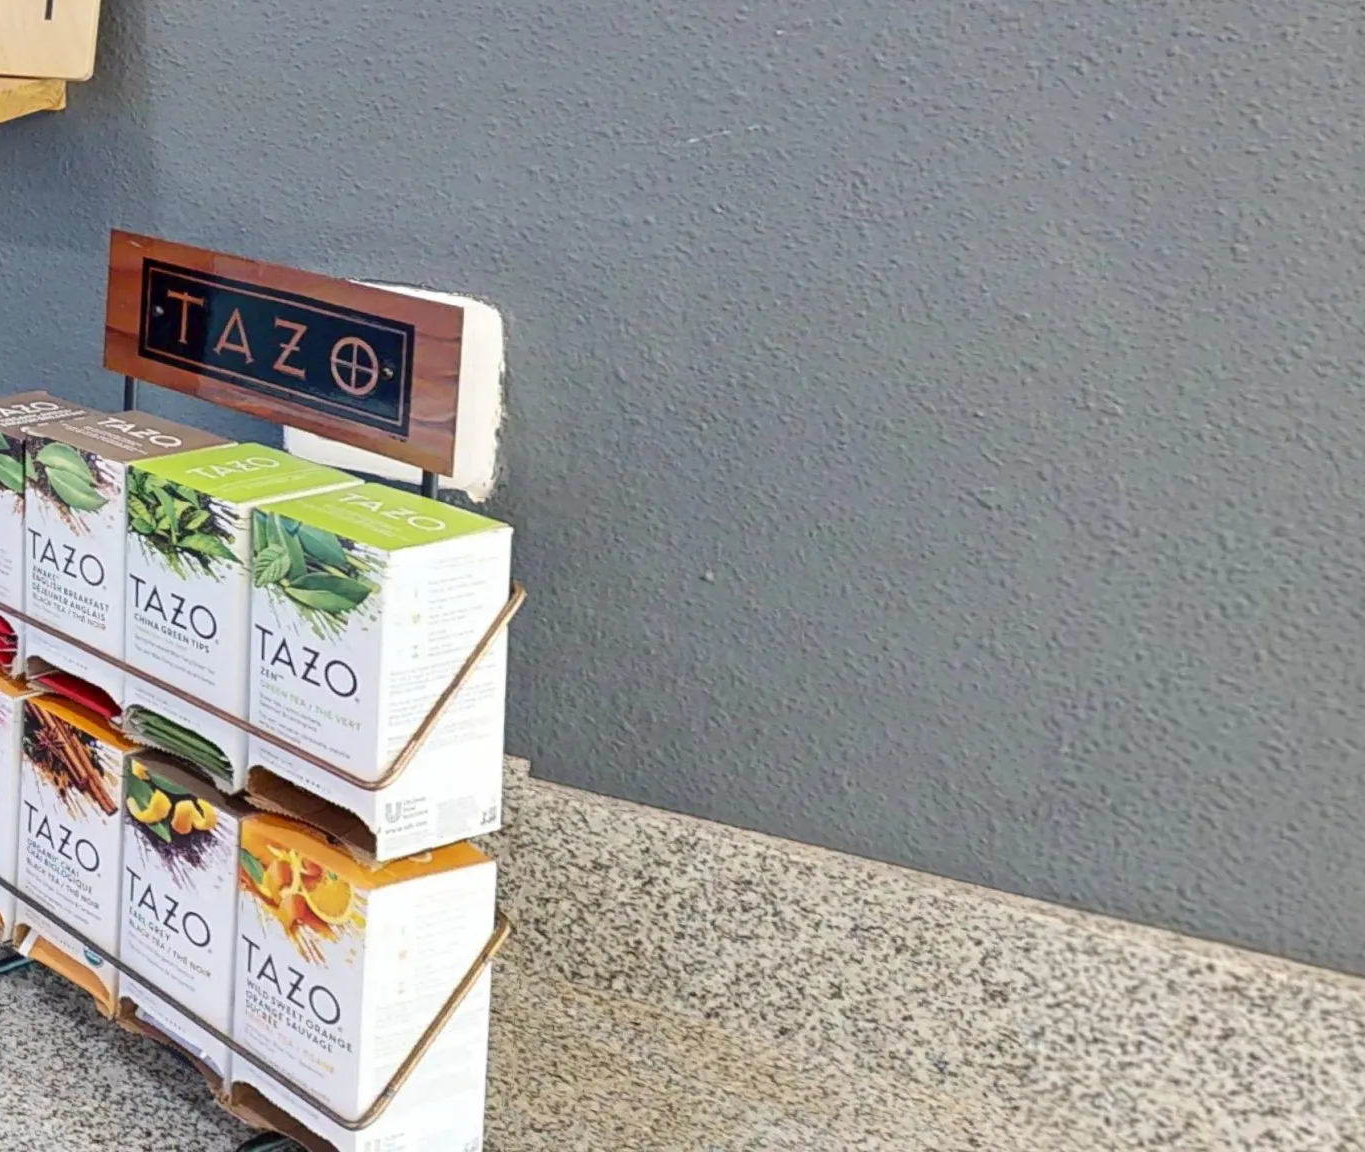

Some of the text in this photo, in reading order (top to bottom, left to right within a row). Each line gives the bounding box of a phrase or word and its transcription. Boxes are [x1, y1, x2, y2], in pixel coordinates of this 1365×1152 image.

[167, 290, 379, 396] TAZO
[97, 417, 183, 448] TAZO
[185, 456, 281, 479] TAZO
[337, 493, 447, 532] TAZO
[27, 527, 105, 587] TAZO
[31, 592, 53, 608] BLACK
[32, 572, 110, 612] ENGLISH BREAKFAST
[69, 600, 106, 622] ANGLAIS
[129, 573, 217, 640] TAZO
[133, 612, 160, 631] CHINA
[160, 625, 190, 644] GREEN
[191, 638, 210, 654] TIPS
[254, 623, 358, 698] TAZO
[260, 679, 288, 698] GREEN
[289, 692, 306, 709] TEA
[335, 714, 361, 732] VERT
[24, 800, 100, 872] TAZO
[26, 856, 46, 874] BLACK
[47, 870, 60, 885] TEA
[44, 858, 92, 894] BIOLOGIQUE
[60, 860, 80, 878] CHAI
[126, 865, 210, 947] TAZO
[129, 906, 171, 942] EARL GREY
[241, 933, 341, 1025] TAZO
[245, 990, 283, 1024] ORANGE
[285, 1018, 334, 1054] SAUVAGE
[246, 978, 269, 1000] WILD
[270, 993, 304, 1023] SWEET
[305, 1018, 353, 1054] ORANGE
